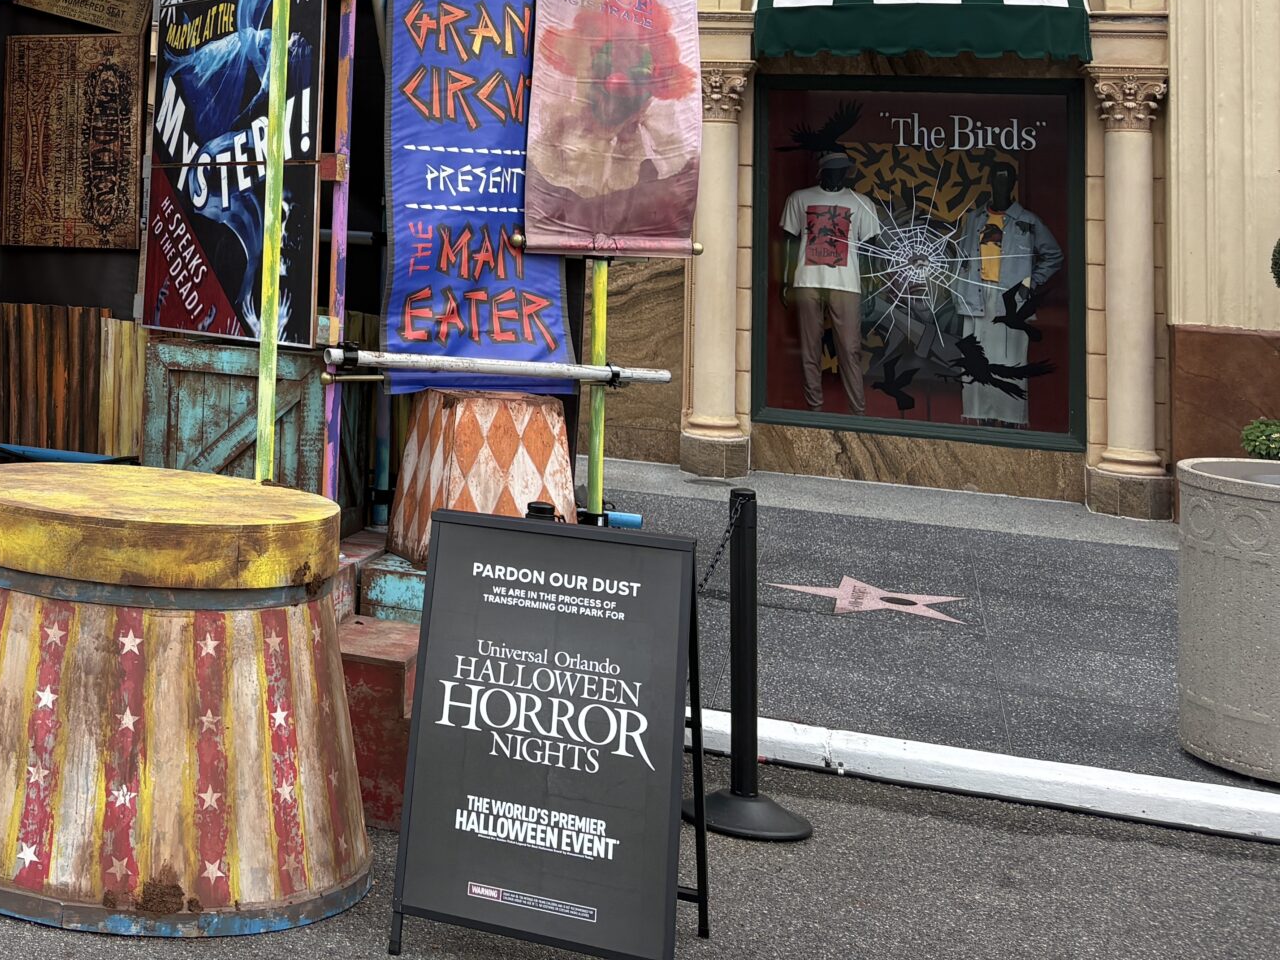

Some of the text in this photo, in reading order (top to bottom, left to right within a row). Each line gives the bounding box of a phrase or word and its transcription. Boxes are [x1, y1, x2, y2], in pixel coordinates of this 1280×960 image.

[106, 5, 126, 19] SEAT
[166, 2, 235, 49] MARVEL AT THE
[400, 66, 533, 130] CIRCU
[160, 196, 207, 284] HE SPEAKS
[408, 221, 433, 278] THE
[437, 223, 525, 282] MAN
[151, 214, 203, 320] TO THE DEAD!
[399, 286, 558, 351] EATER
[472, 562, 641, 597] PARDON OUR DUST
[492, 585, 617, 610] WE ARE IN THE PROCESS OF
[483, 594, 625, 621] TRANSFORMING OUR PARK FOR
[477, 639, 621, 675] Universal Orlando
[453, 654, 643, 708] HALLOWEEN
[435, 679, 656, 772] HORROR
[488, 730, 600, 774] NIGHTS
[454, 808, 559, 849] HALLOWEEN
[466, 794, 607, 837] THE WORLD'S PREMIER
[471, 884, 498, 899] WARNING
